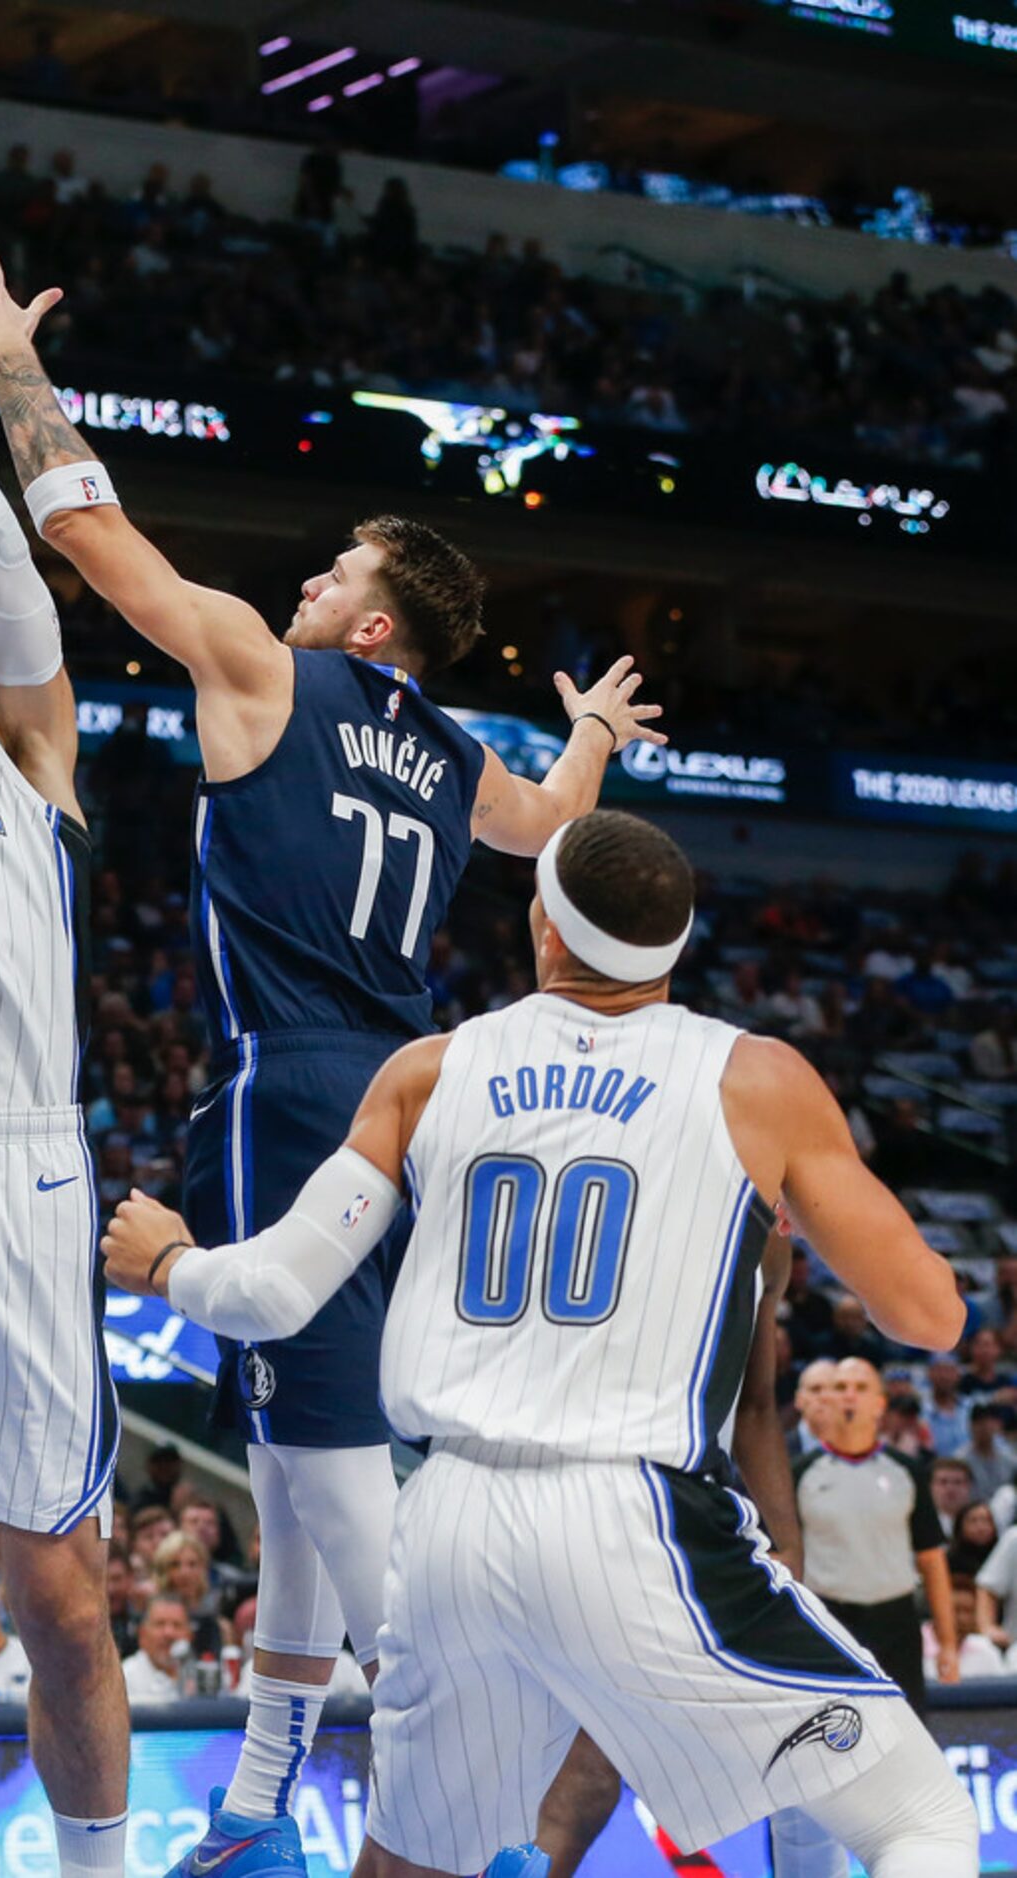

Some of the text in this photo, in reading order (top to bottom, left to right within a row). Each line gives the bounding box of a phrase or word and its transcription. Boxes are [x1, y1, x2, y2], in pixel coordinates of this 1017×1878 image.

[146, 706, 185, 741] RX
[337, 722, 447, 801] DONČIĆ
[667, 749, 786, 785] LEXUS
[853, 769, 894, 802] THE
[332, 792, 434, 959] 77
[488, 1064, 657, 1125] GORDON
[454, 1152, 639, 1327] 00
